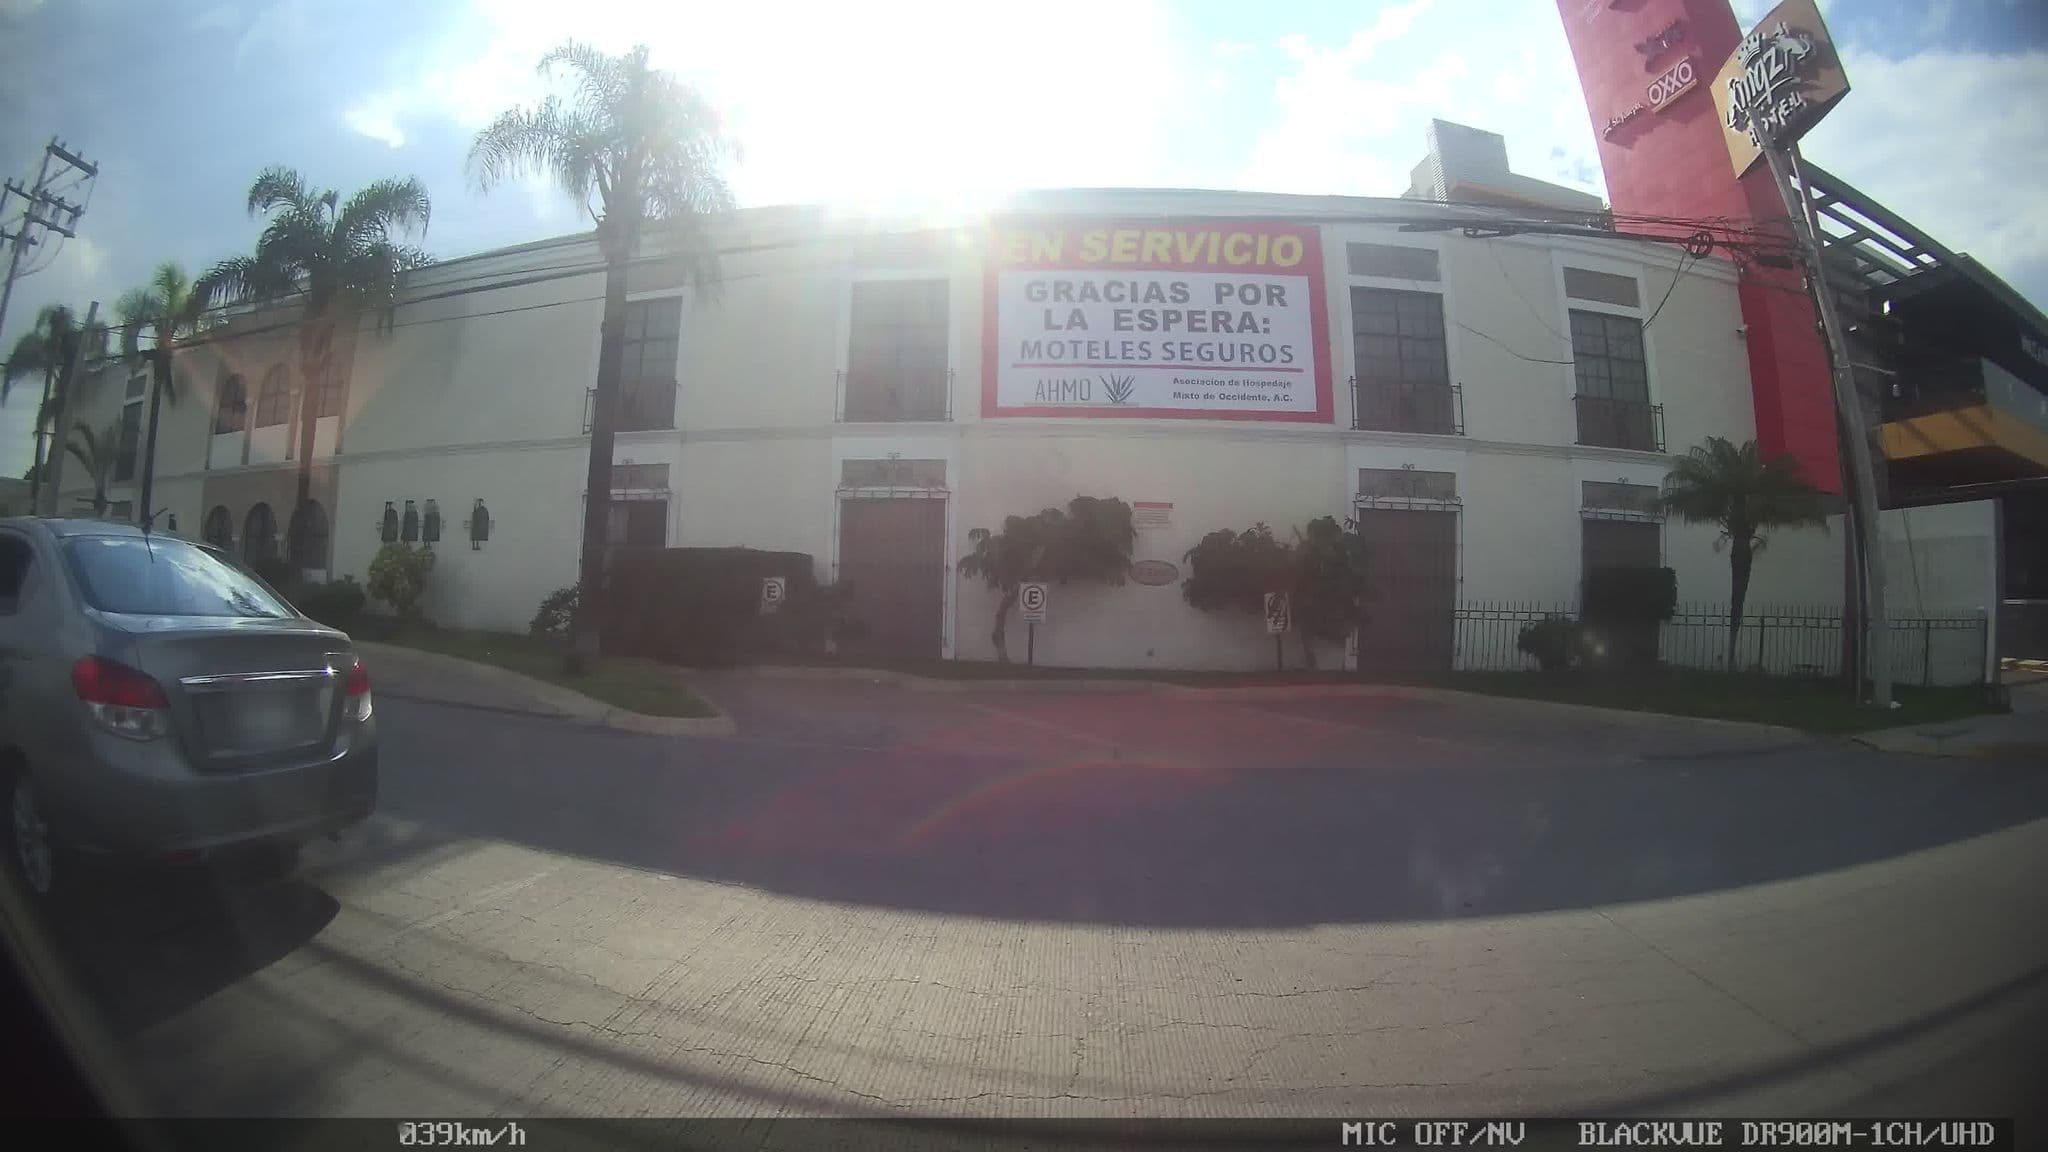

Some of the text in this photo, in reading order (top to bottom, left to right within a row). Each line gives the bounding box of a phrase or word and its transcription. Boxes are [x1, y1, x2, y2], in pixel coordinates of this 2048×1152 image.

[1648, 61, 1693, 105] OXXO
[1000, 230, 1304, 267] EN SERVICIO
[1025, 280, 1288, 307] GRACIAS POR
[1044, 308, 1271, 334] LA ESPERA:
[1020, 340, 1294, 364] MOTELES SEGUROS
[1035, 378, 1091, 402] AHMO
[1173, 391, 1200, 401] Mixto
[1203, 391, 1216, 401] de
[1228, 378, 1240, 387] de
[1242, 379, 1292, 390] Hospedaje
[1028, 590, 1039, 605] E
